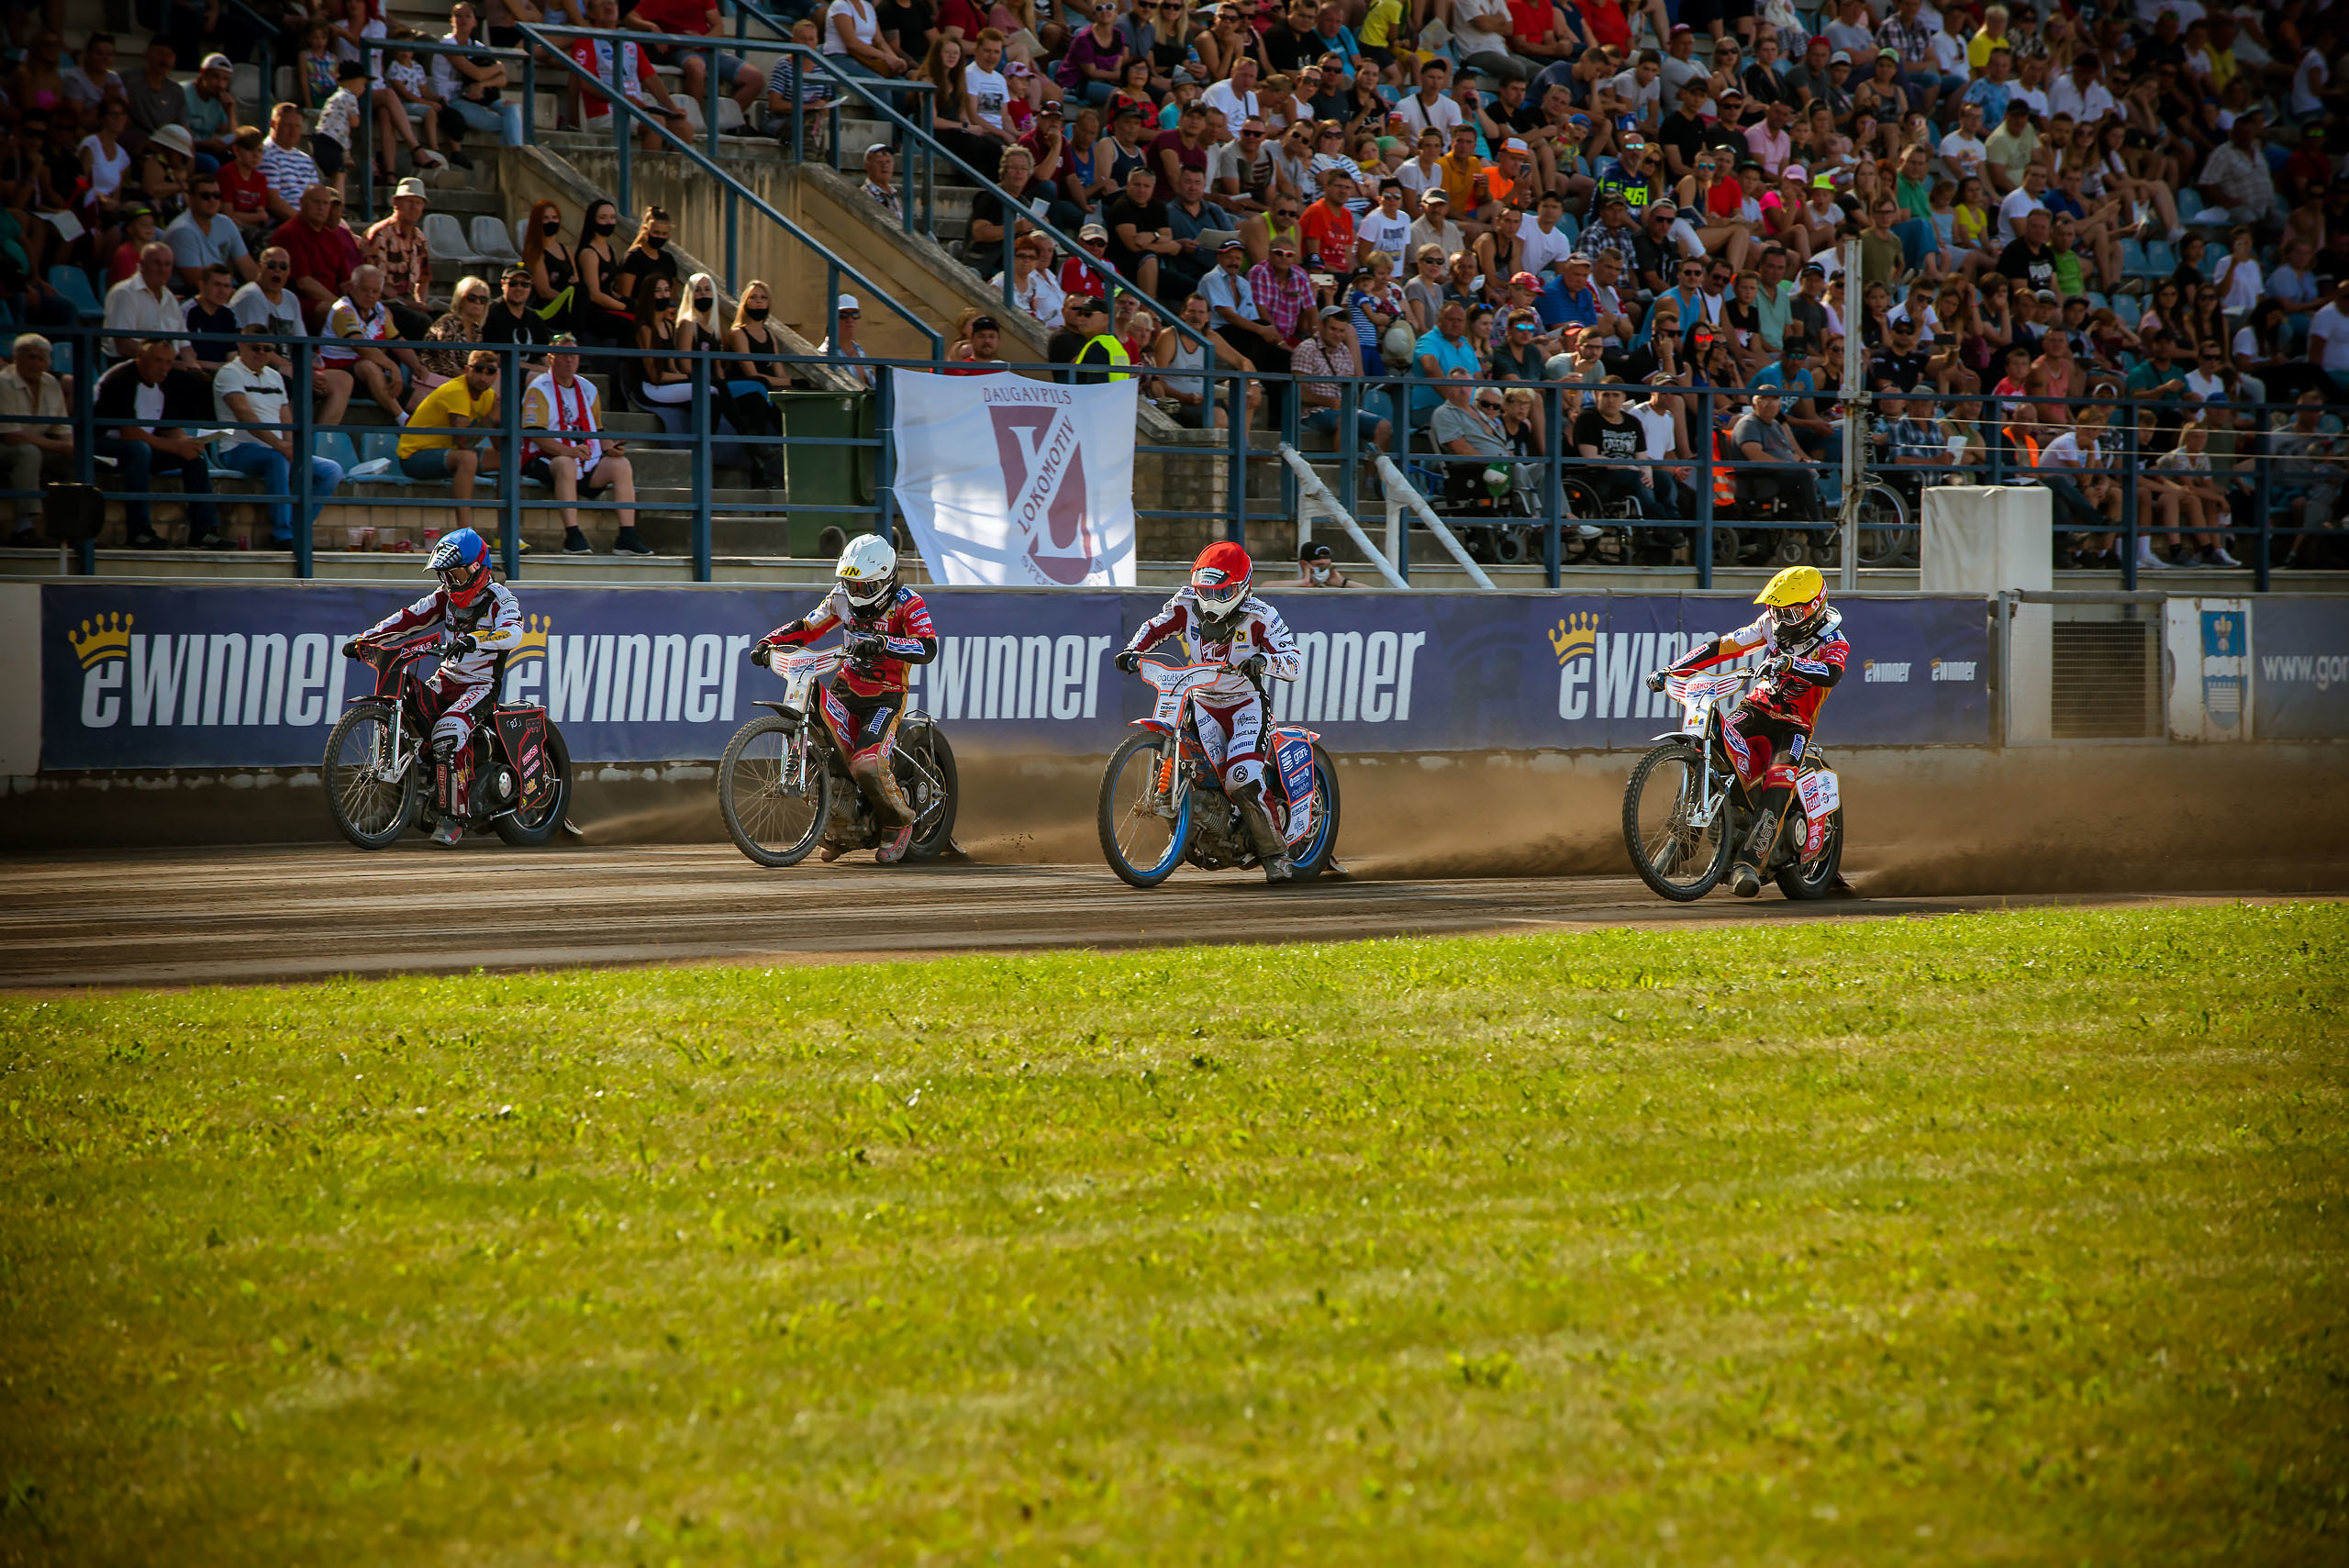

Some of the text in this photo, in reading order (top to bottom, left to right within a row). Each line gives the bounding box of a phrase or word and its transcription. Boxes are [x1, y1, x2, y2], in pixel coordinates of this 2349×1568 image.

[983, 386, 1073, 405] DAUGAVPILS
[1017, 415, 1075, 535] LOKOMOTIV
[907, 635, 1111, 720] Winner
[1806, 795, 1820, 812] TEAM
